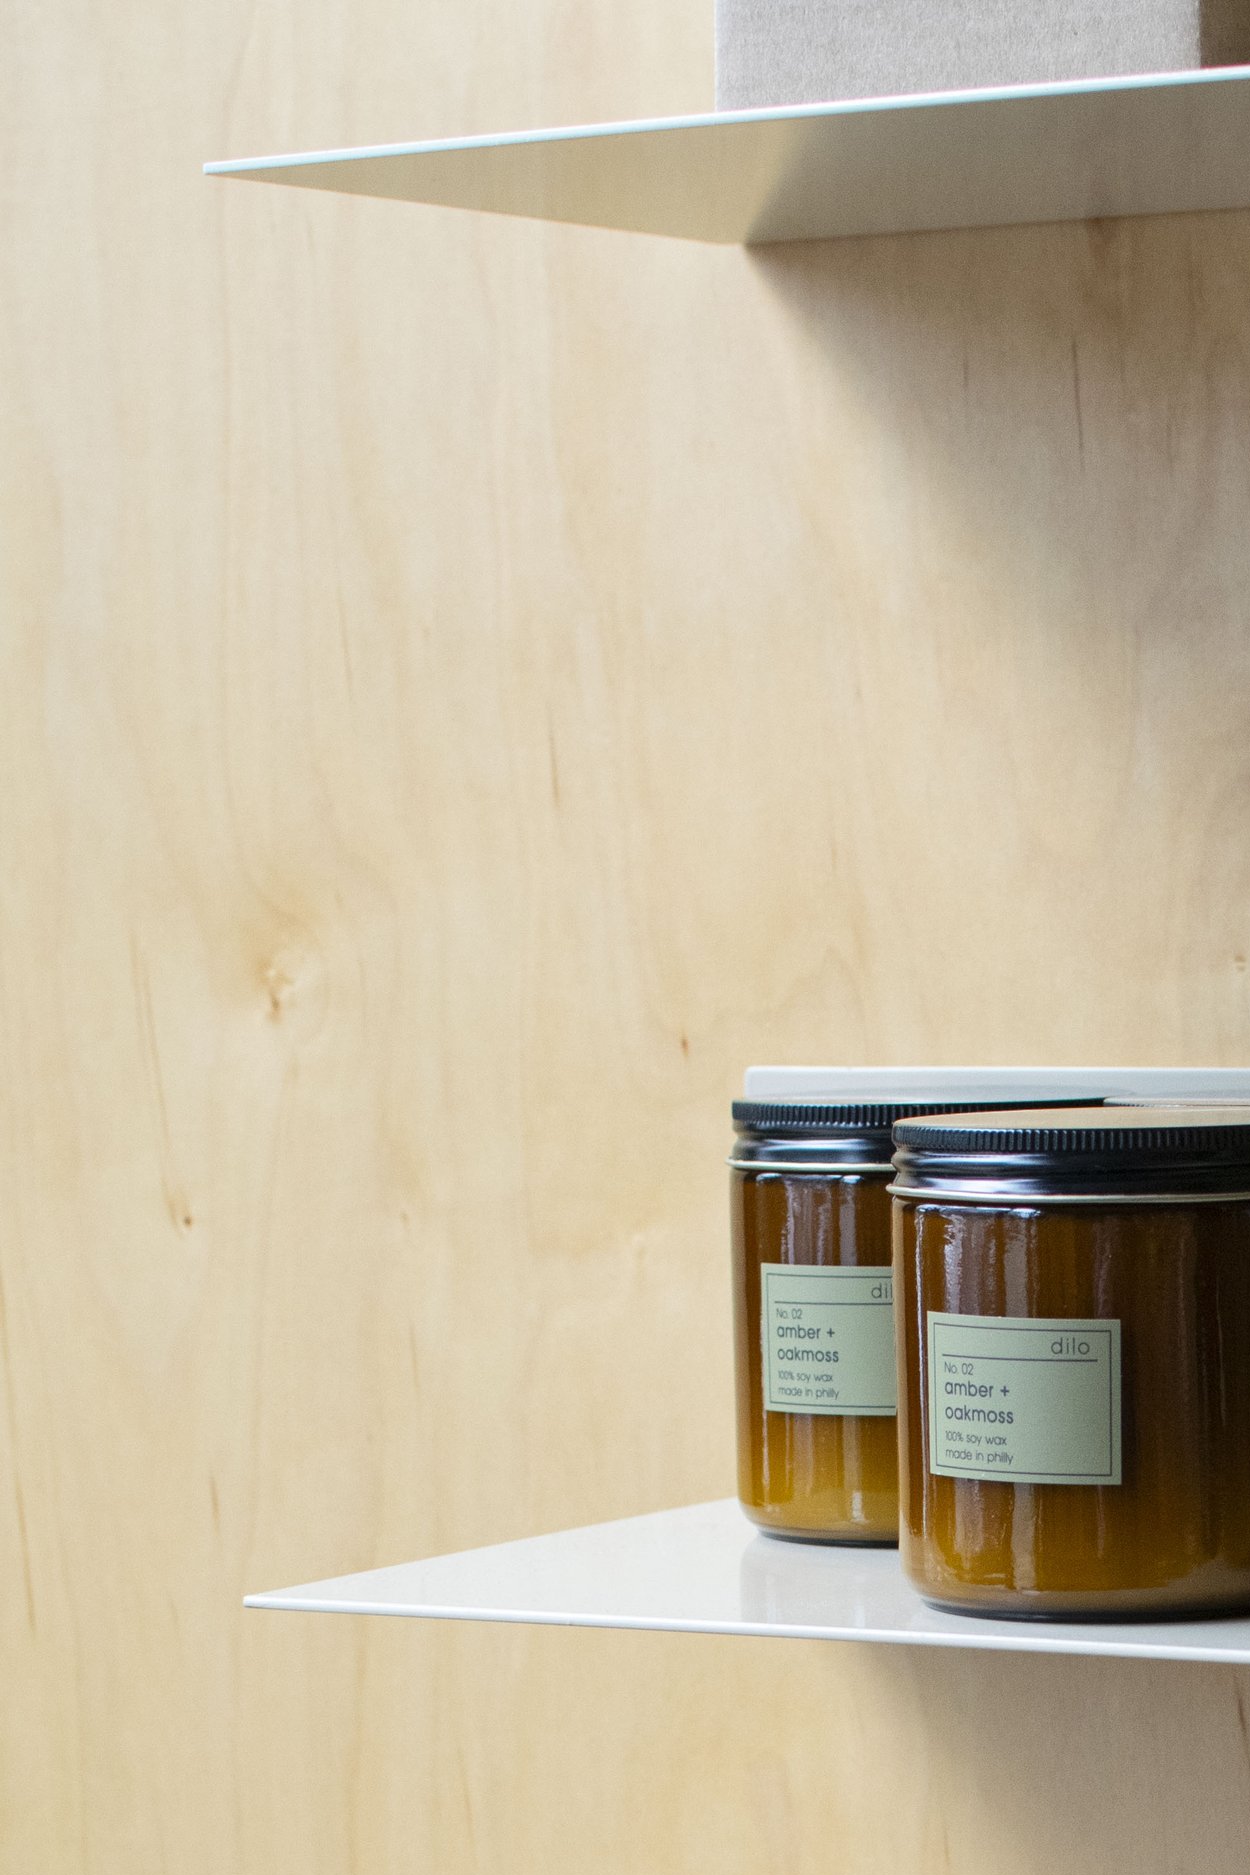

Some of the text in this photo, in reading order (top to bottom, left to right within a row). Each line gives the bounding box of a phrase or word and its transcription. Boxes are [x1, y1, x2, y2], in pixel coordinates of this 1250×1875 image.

[871, 1282, 892, 1299] dil
[792, 1309, 802, 1319] 02
[777, 1325, 835, 1339] amber +
[1051, 1337, 1090, 1355] dilo
[778, 1348, 839, 1362] oakmoss
[778, 1371, 833, 1382] 100% soy wax
[962, 1363, 974, 1375] 02
[778, 1387, 839, 1399] made in philly
[945, 1381, 1010, 1398] amber +
[945, 1405, 1014, 1424] oakmoss
[945, 1430, 1007, 1446] 100% soy wax
[945, 1448, 1014, 1465] made in philly
